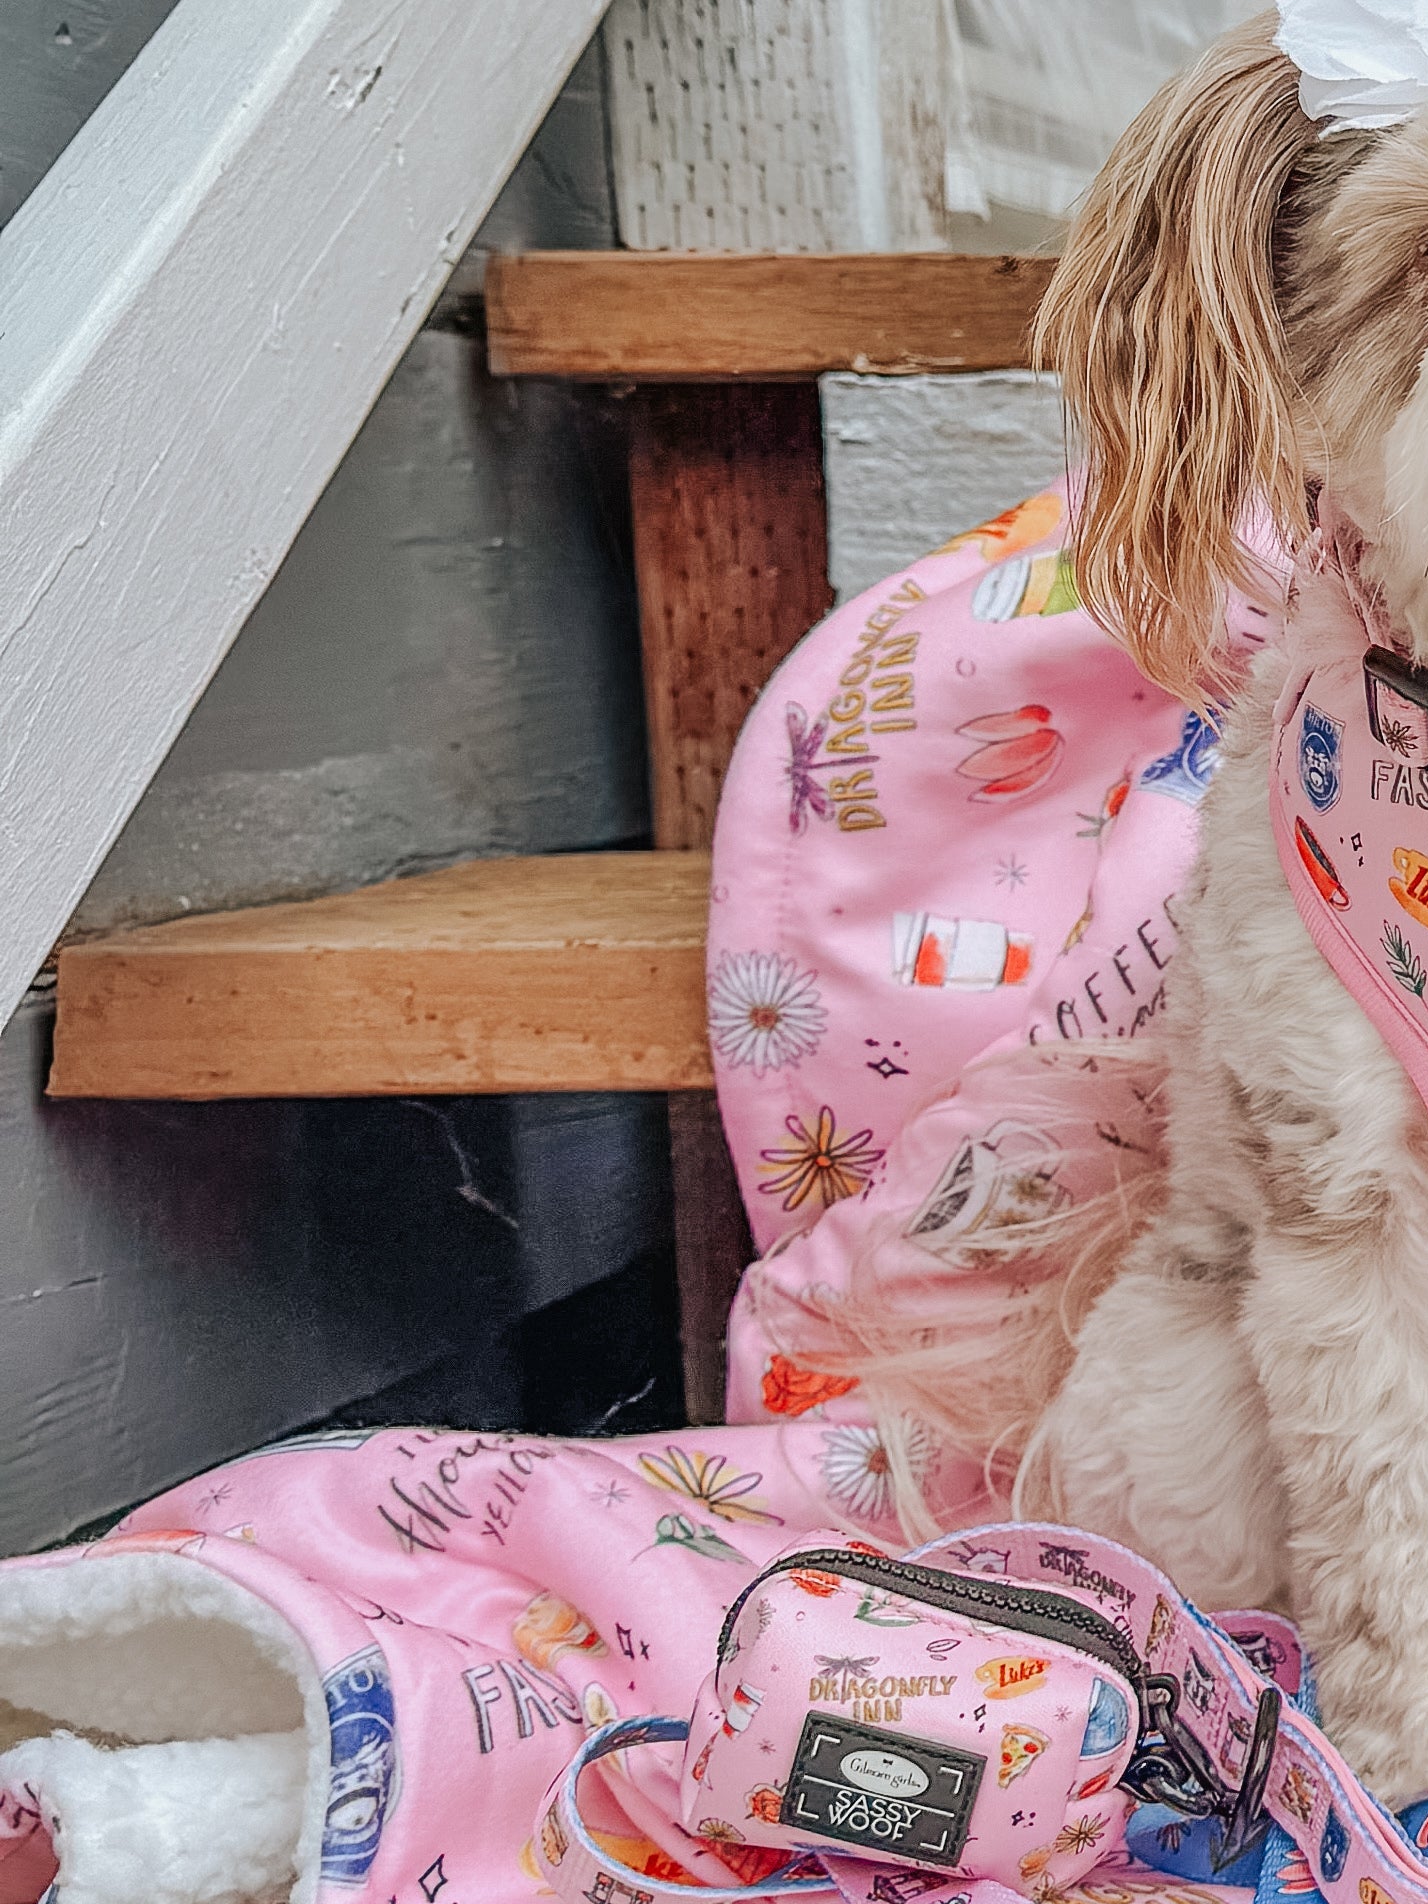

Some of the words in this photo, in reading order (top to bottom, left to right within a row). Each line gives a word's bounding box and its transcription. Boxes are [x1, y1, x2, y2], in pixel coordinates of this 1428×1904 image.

[870, 631, 924, 734] INN
[461, 1658, 585, 1756] FAS
[808, 1675, 958, 1702] DRAGONFLY
[853, 1698, 903, 1723] INN
[828, 1802, 913, 1841] WOOF
[835, 1789, 922, 1825] SASSY
